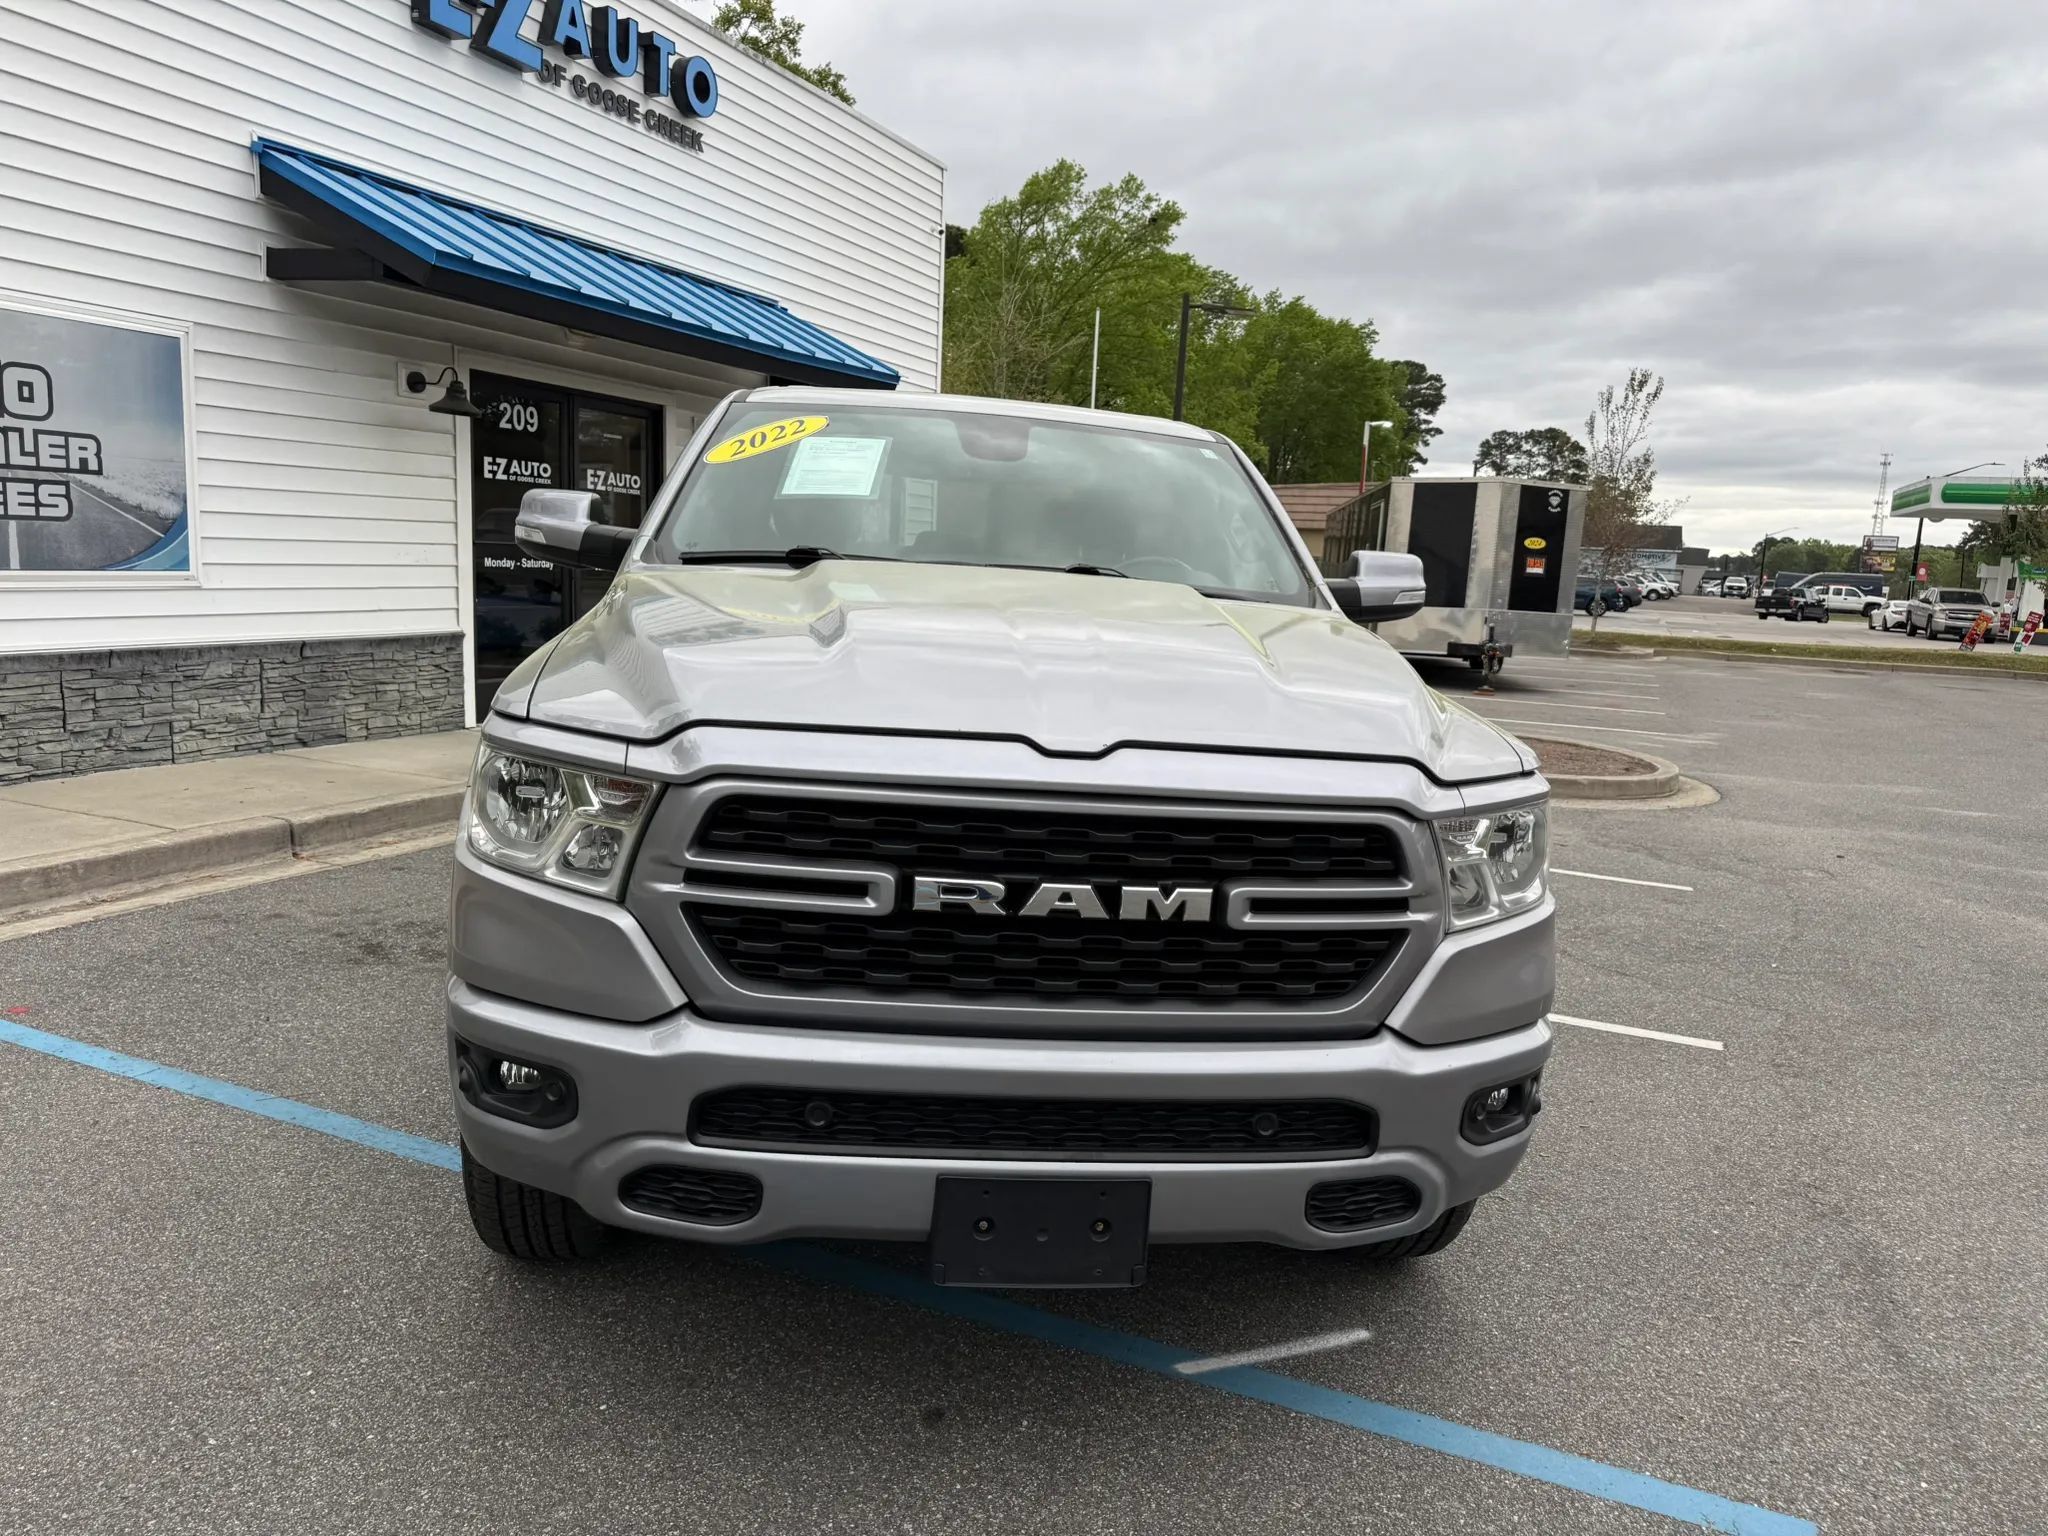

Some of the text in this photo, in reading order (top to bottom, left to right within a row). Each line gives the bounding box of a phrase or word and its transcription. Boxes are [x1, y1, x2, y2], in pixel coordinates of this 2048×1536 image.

[540, 0, 718, 118] AUTO
[538, 58, 706, 153] OF GOOSE CREEK
[499, 402, 538, 432] 209
[0, 426, 103, 475] LER
[729, 419, 806, 458] 2022
[483, 456, 552, 480] E-Z AUTO
[587, 469, 641, 491] E-Z AUTO
[0, 477, 73, 521] ES
[484, 557, 515, 570] Monday
[521, 558, 554, 571] Saturday
[913, 876, 1213, 921] RAM
